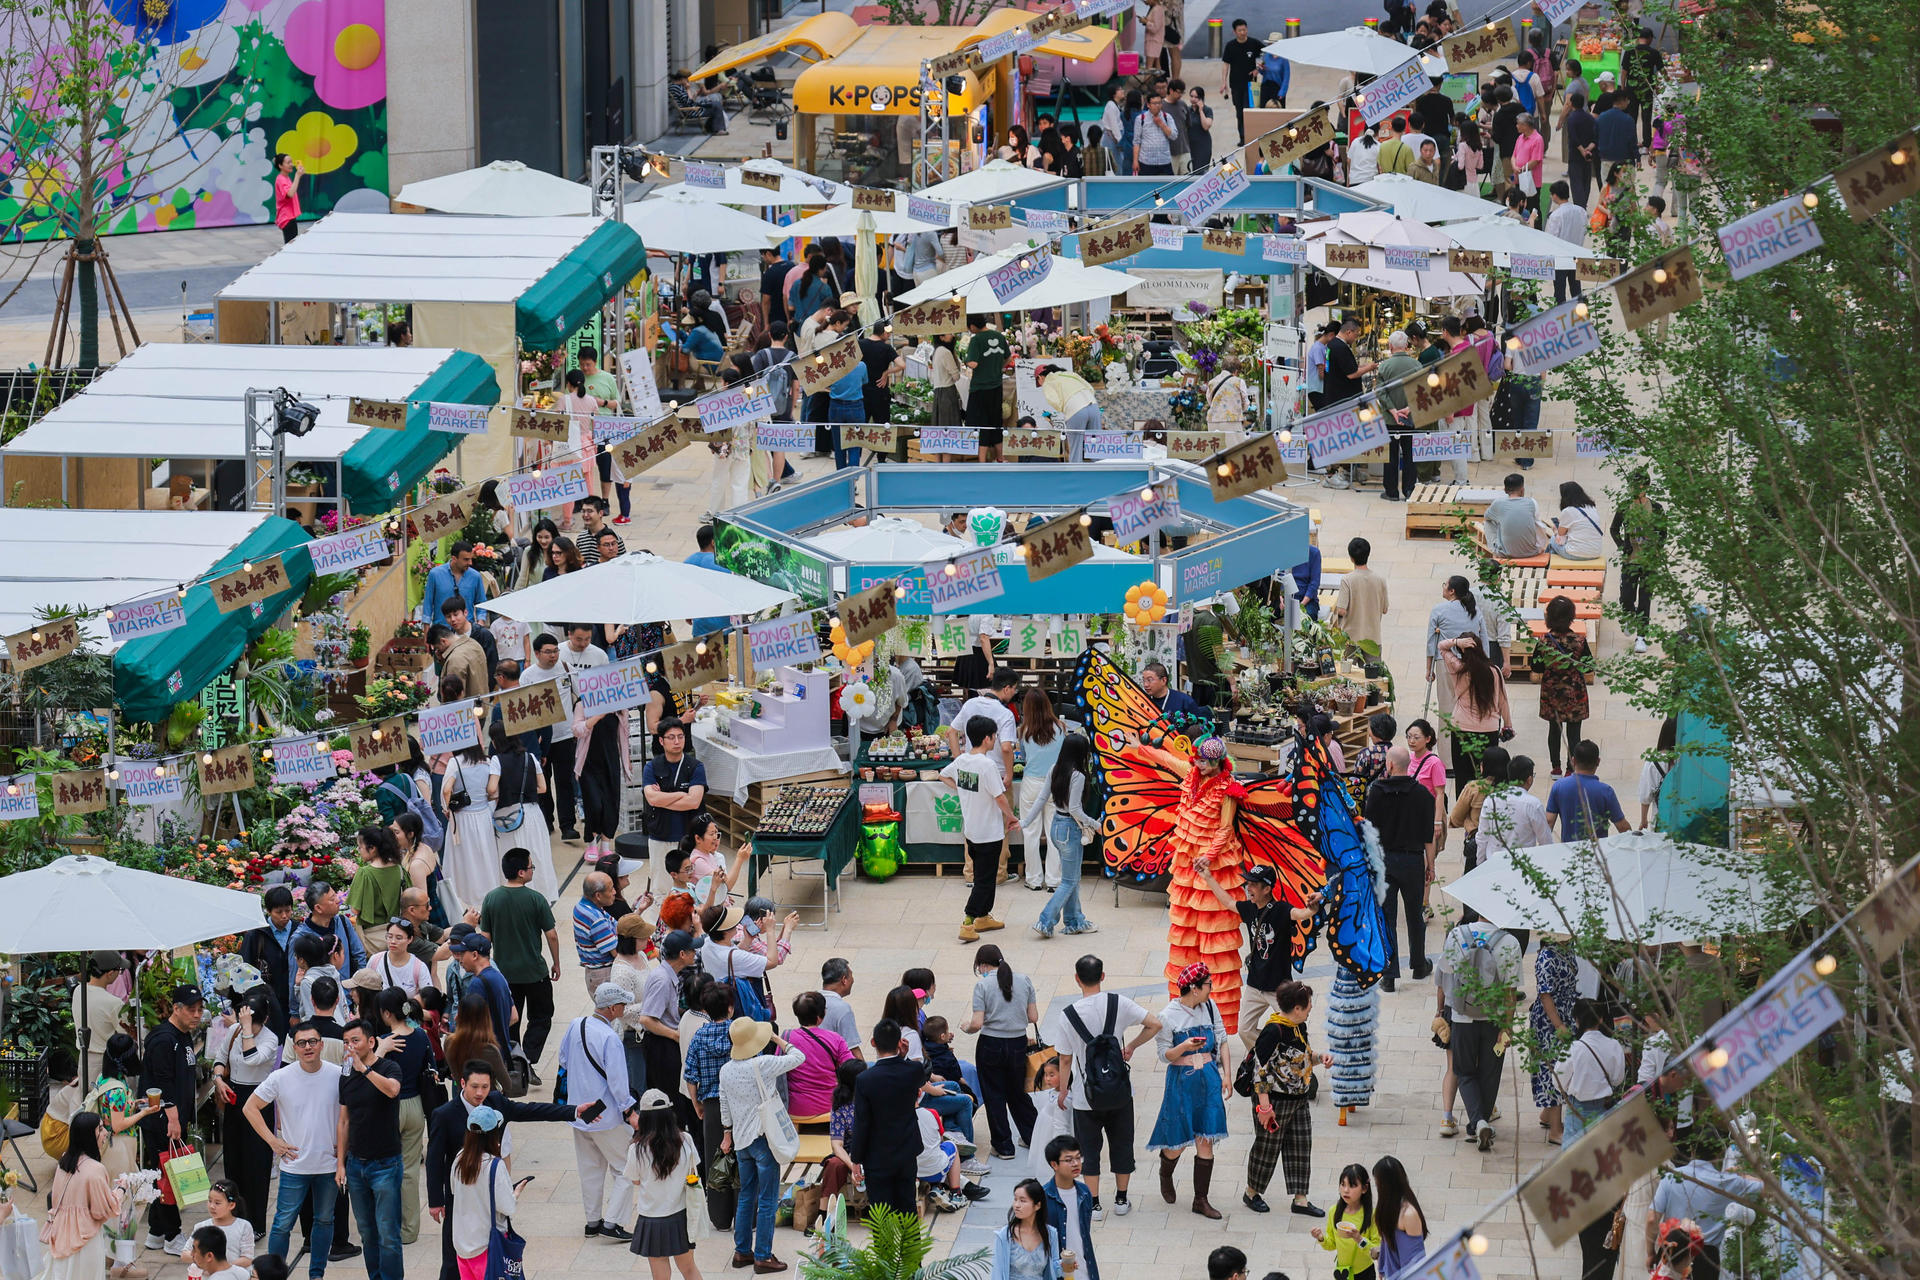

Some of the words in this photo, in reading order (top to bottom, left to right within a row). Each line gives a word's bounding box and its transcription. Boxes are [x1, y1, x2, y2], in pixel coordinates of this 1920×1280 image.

[1360, 73, 1425, 120] MARKET
[685, 174, 725, 185] MARKET
[1183, 169, 1246, 222] MARKET
[909, 208, 949, 223] MARKET
[1026, 220, 1068, 230] MARKET
[1152, 236, 1183, 246] ARKET
[1726, 220, 1815, 269] MARKET
[1263, 248, 1306, 260] MARKET
[1385, 257, 1430, 268] MARKET
[993, 259, 1050, 300] MARKE
[1511, 266, 1554, 276] MARKET
[1139, 279, 1210, 292] BLOOMMANOR
[1518, 322, 1593, 367] MARKET
[429, 416, 488, 429] MARKET
[701, 394, 773, 426] MARKET
[756, 436, 816, 448] MARKET
[920, 438, 979, 450] MARKET
[1084, 443, 1144, 454] MARKET
[1308, 418, 1384, 459] MARKET
[1412, 444, 1471, 457] MARKET
[512, 479, 588, 507] MARKET
[1115, 500, 1180, 537] MARKET
[313, 540, 386, 570] MARKET
[1184, 557, 1223, 581] DONGTAI
[931, 570, 998, 604] MARKET
[1184, 569, 1222, 595] MARKET
[109, 608, 184, 636] MARKET
[752, 636, 816, 664] MARKET
[1058, 624, 1080, 652] 肉
[581, 681, 648, 709] MARKET
[421, 723, 477, 748] MARKET
[275, 754, 333, 776] MARKET
[126, 778, 181, 797] MARKET
[0, 795, 36, 812] ARKET
[1705, 984, 1832, 1100] MARKET
